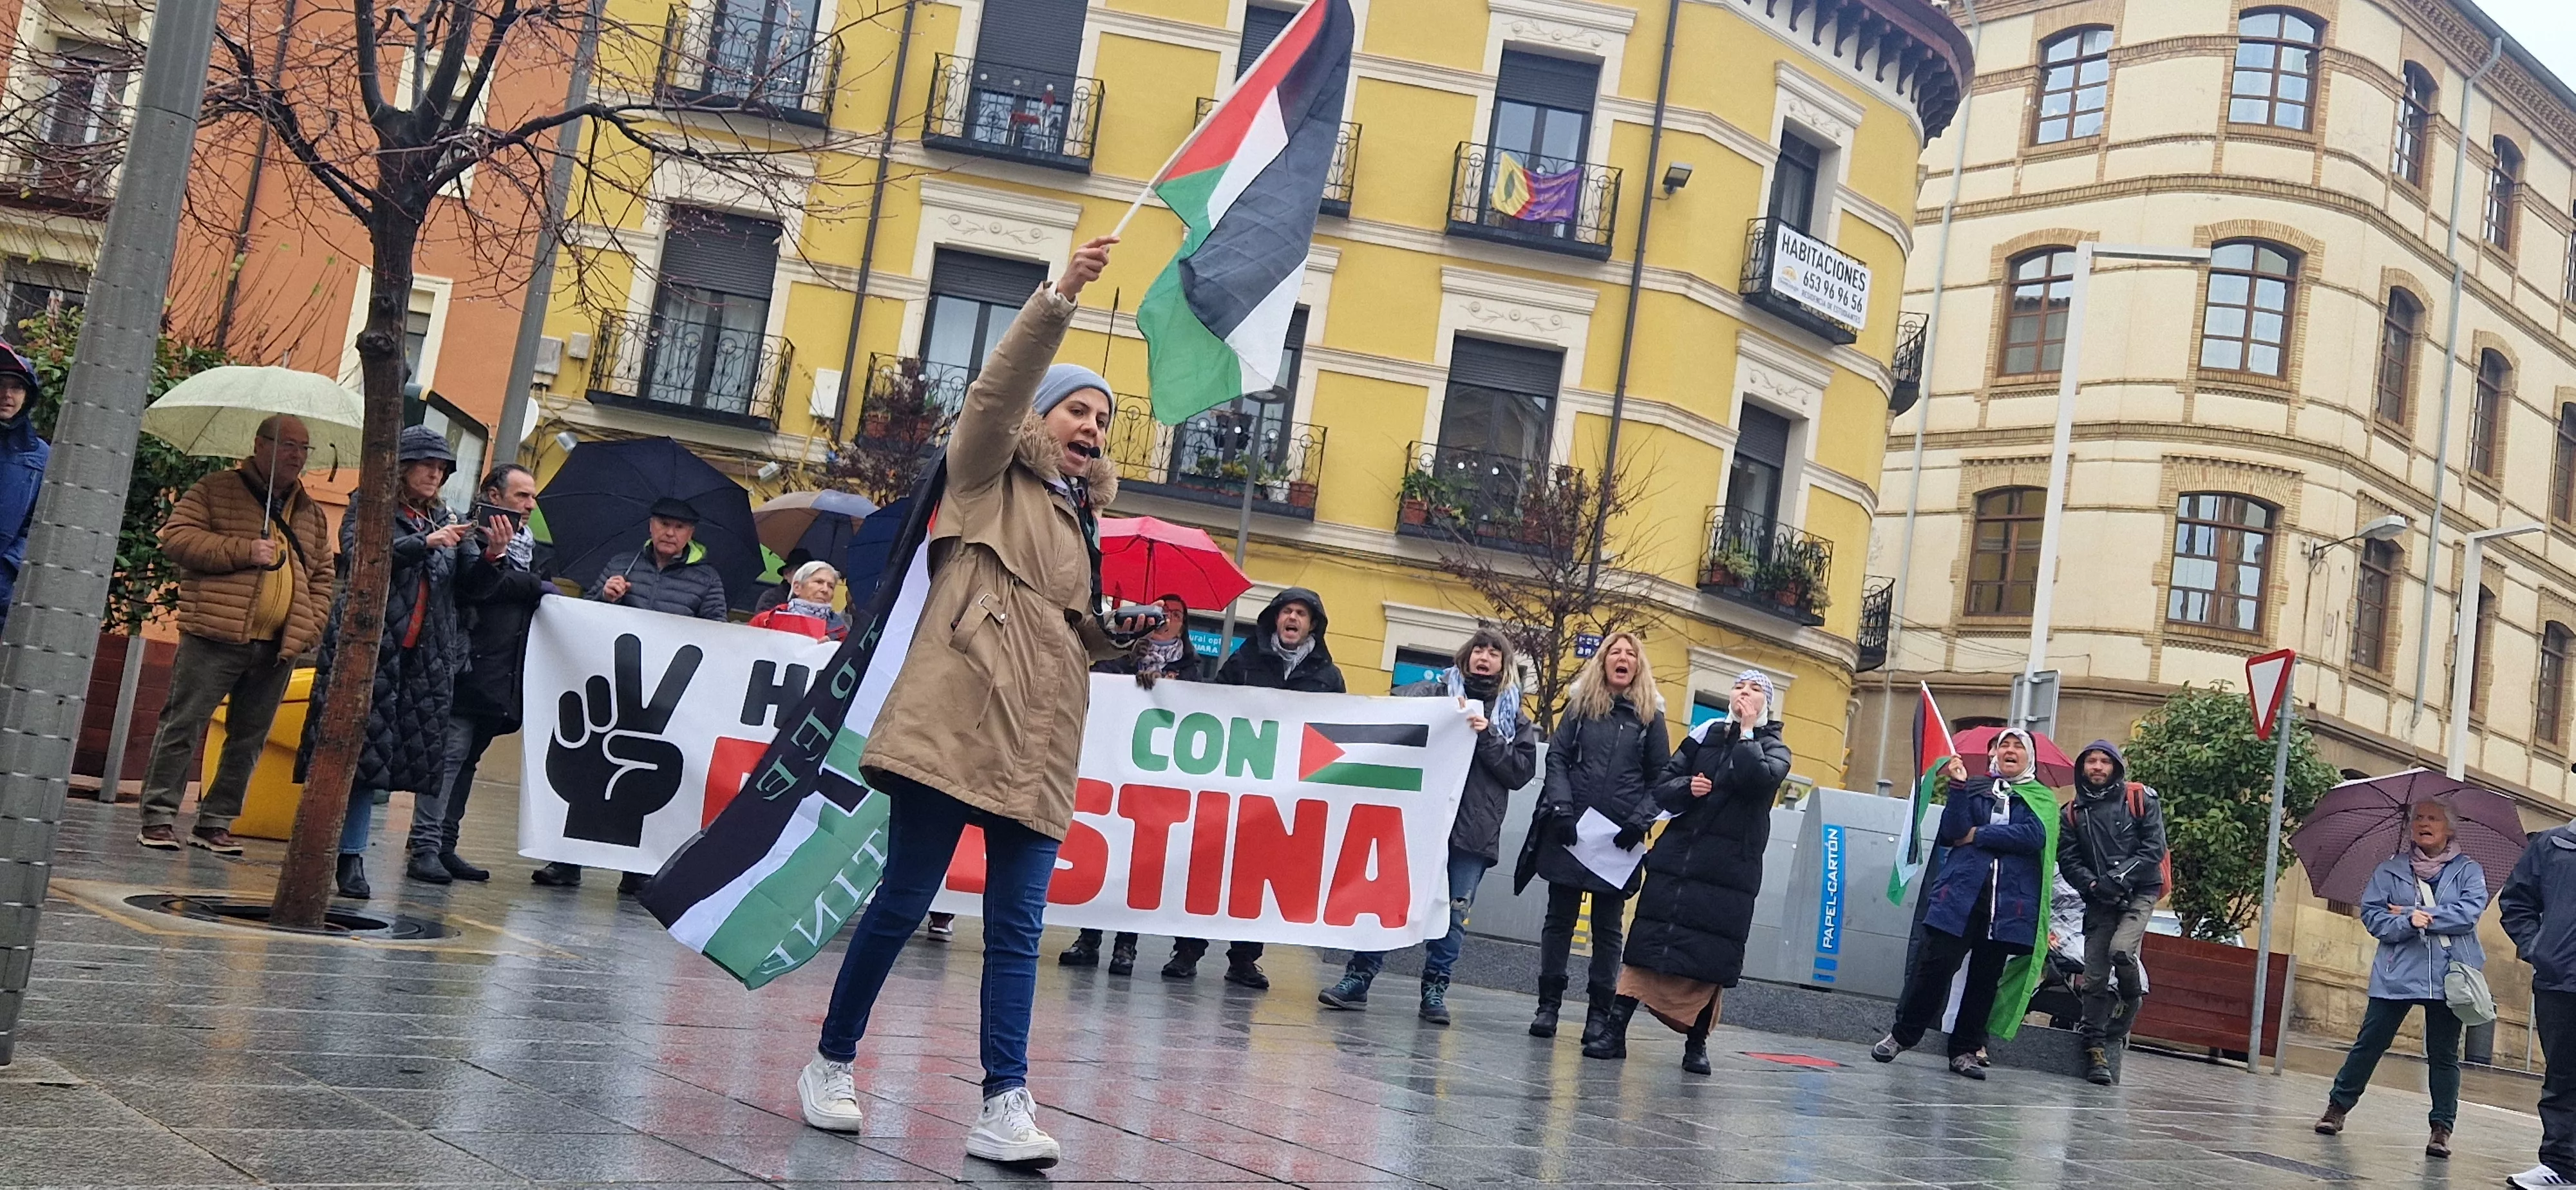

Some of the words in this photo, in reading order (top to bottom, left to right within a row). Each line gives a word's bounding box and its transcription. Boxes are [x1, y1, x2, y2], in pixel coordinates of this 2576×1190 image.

[1781, 232, 1866, 292] HABITACIONES
[1803, 270, 1821, 292] 653
[1824, 280, 1834, 299] 96
[1838, 287, 1848, 307] 96
[1851, 294, 1862, 312] 56
[1189, 634, 1206, 643] ural
[1194, 645, 1218, 654] UARA
[1132, 708, 1279, 780] CON
[1823, 828, 1839, 949] PAPEL-CARTÓN
